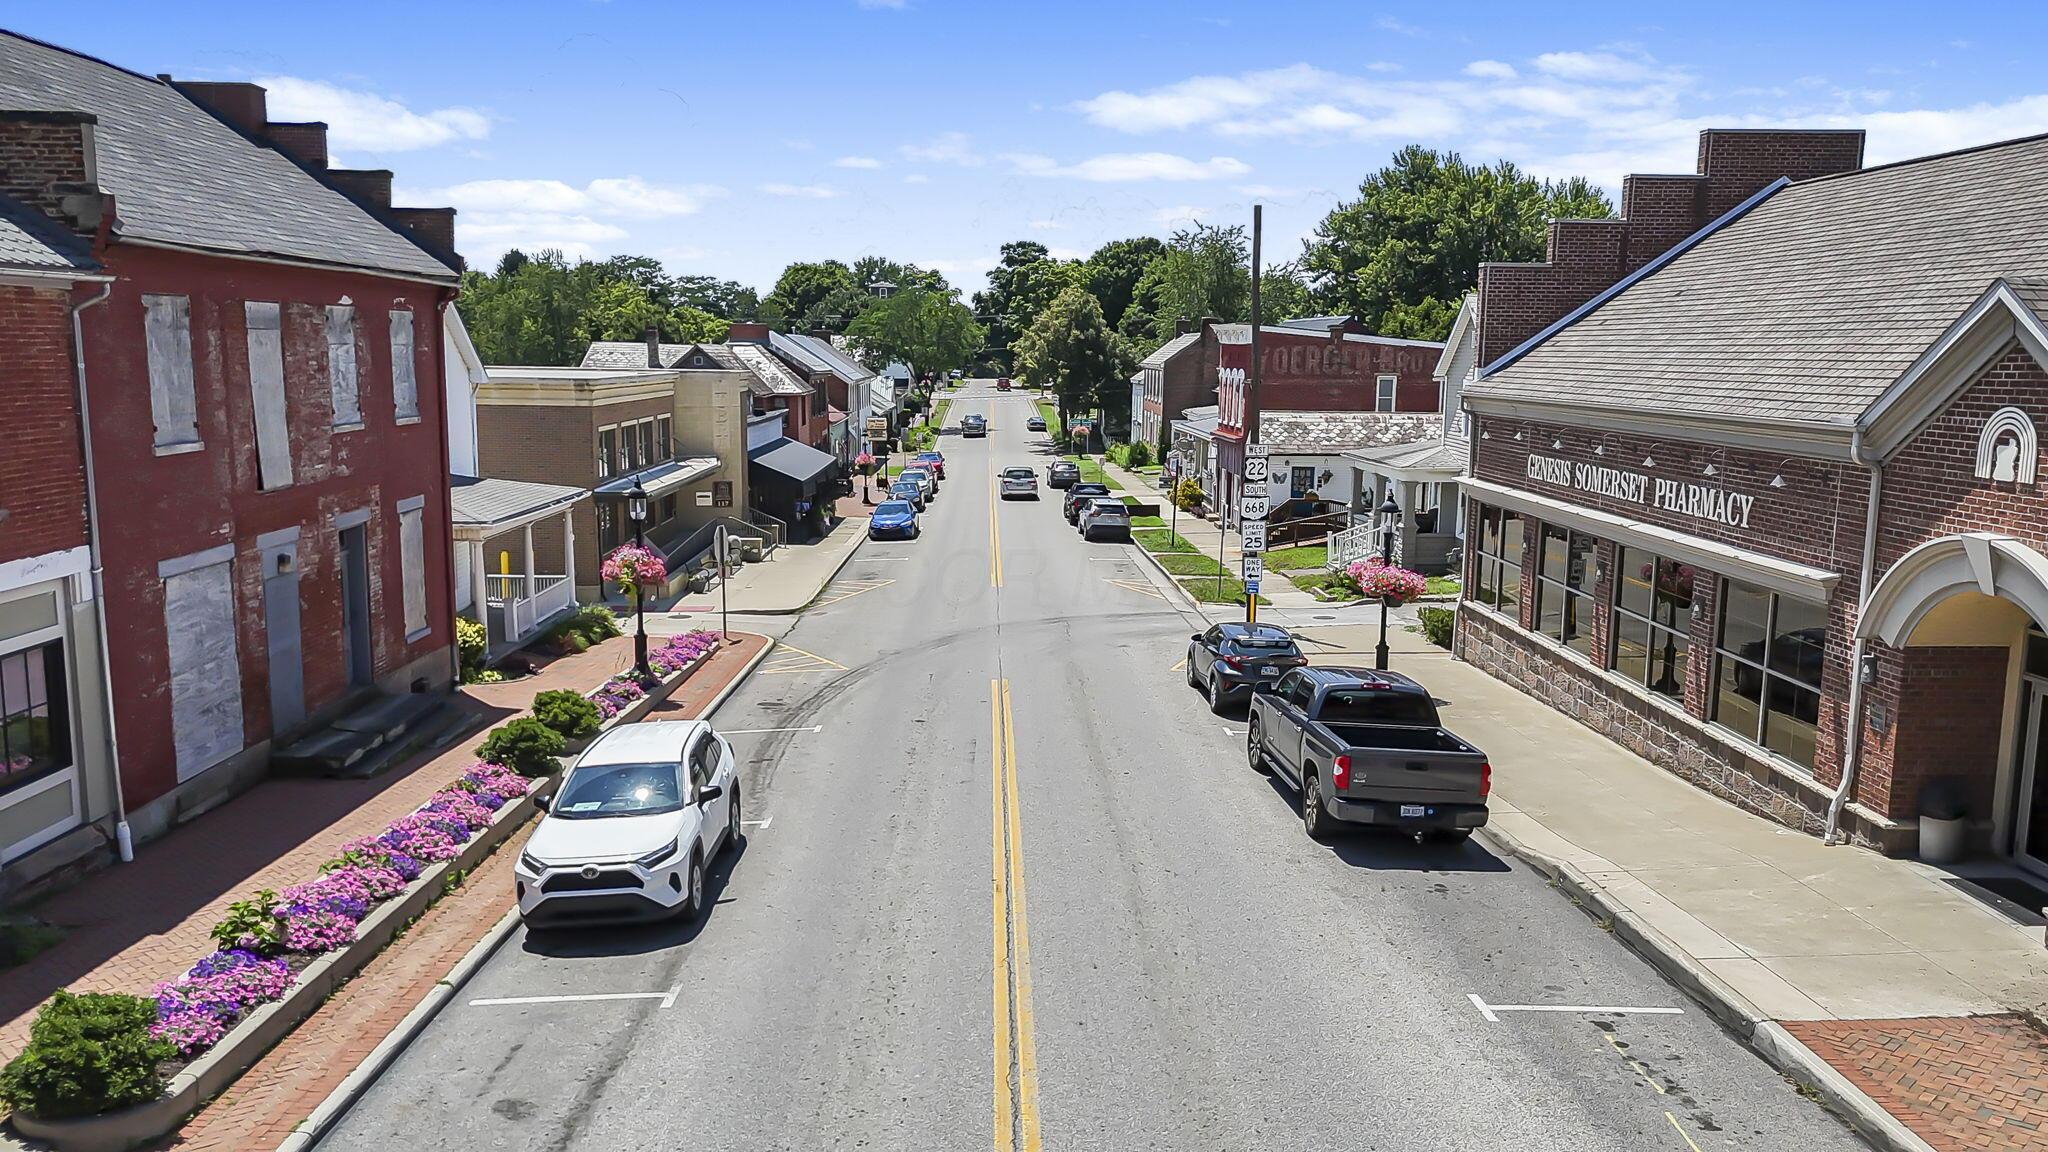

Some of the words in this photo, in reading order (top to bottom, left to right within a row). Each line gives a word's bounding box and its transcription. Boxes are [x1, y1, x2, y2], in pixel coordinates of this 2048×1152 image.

[1248, 446, 1266, 454] WEST
[1248, 461, 1265, 476] 22
[1245, 485, 1267, 494] SOUTH
[1527, 453, 1571, 487] GENESIS
[1574, 462, 1649, 504] SOMERSET
[1653, 477, 1755, 529] PHARMACY
[1244, 501, 1265, 513] 668
[1244, 537, 1263, 549] 25
